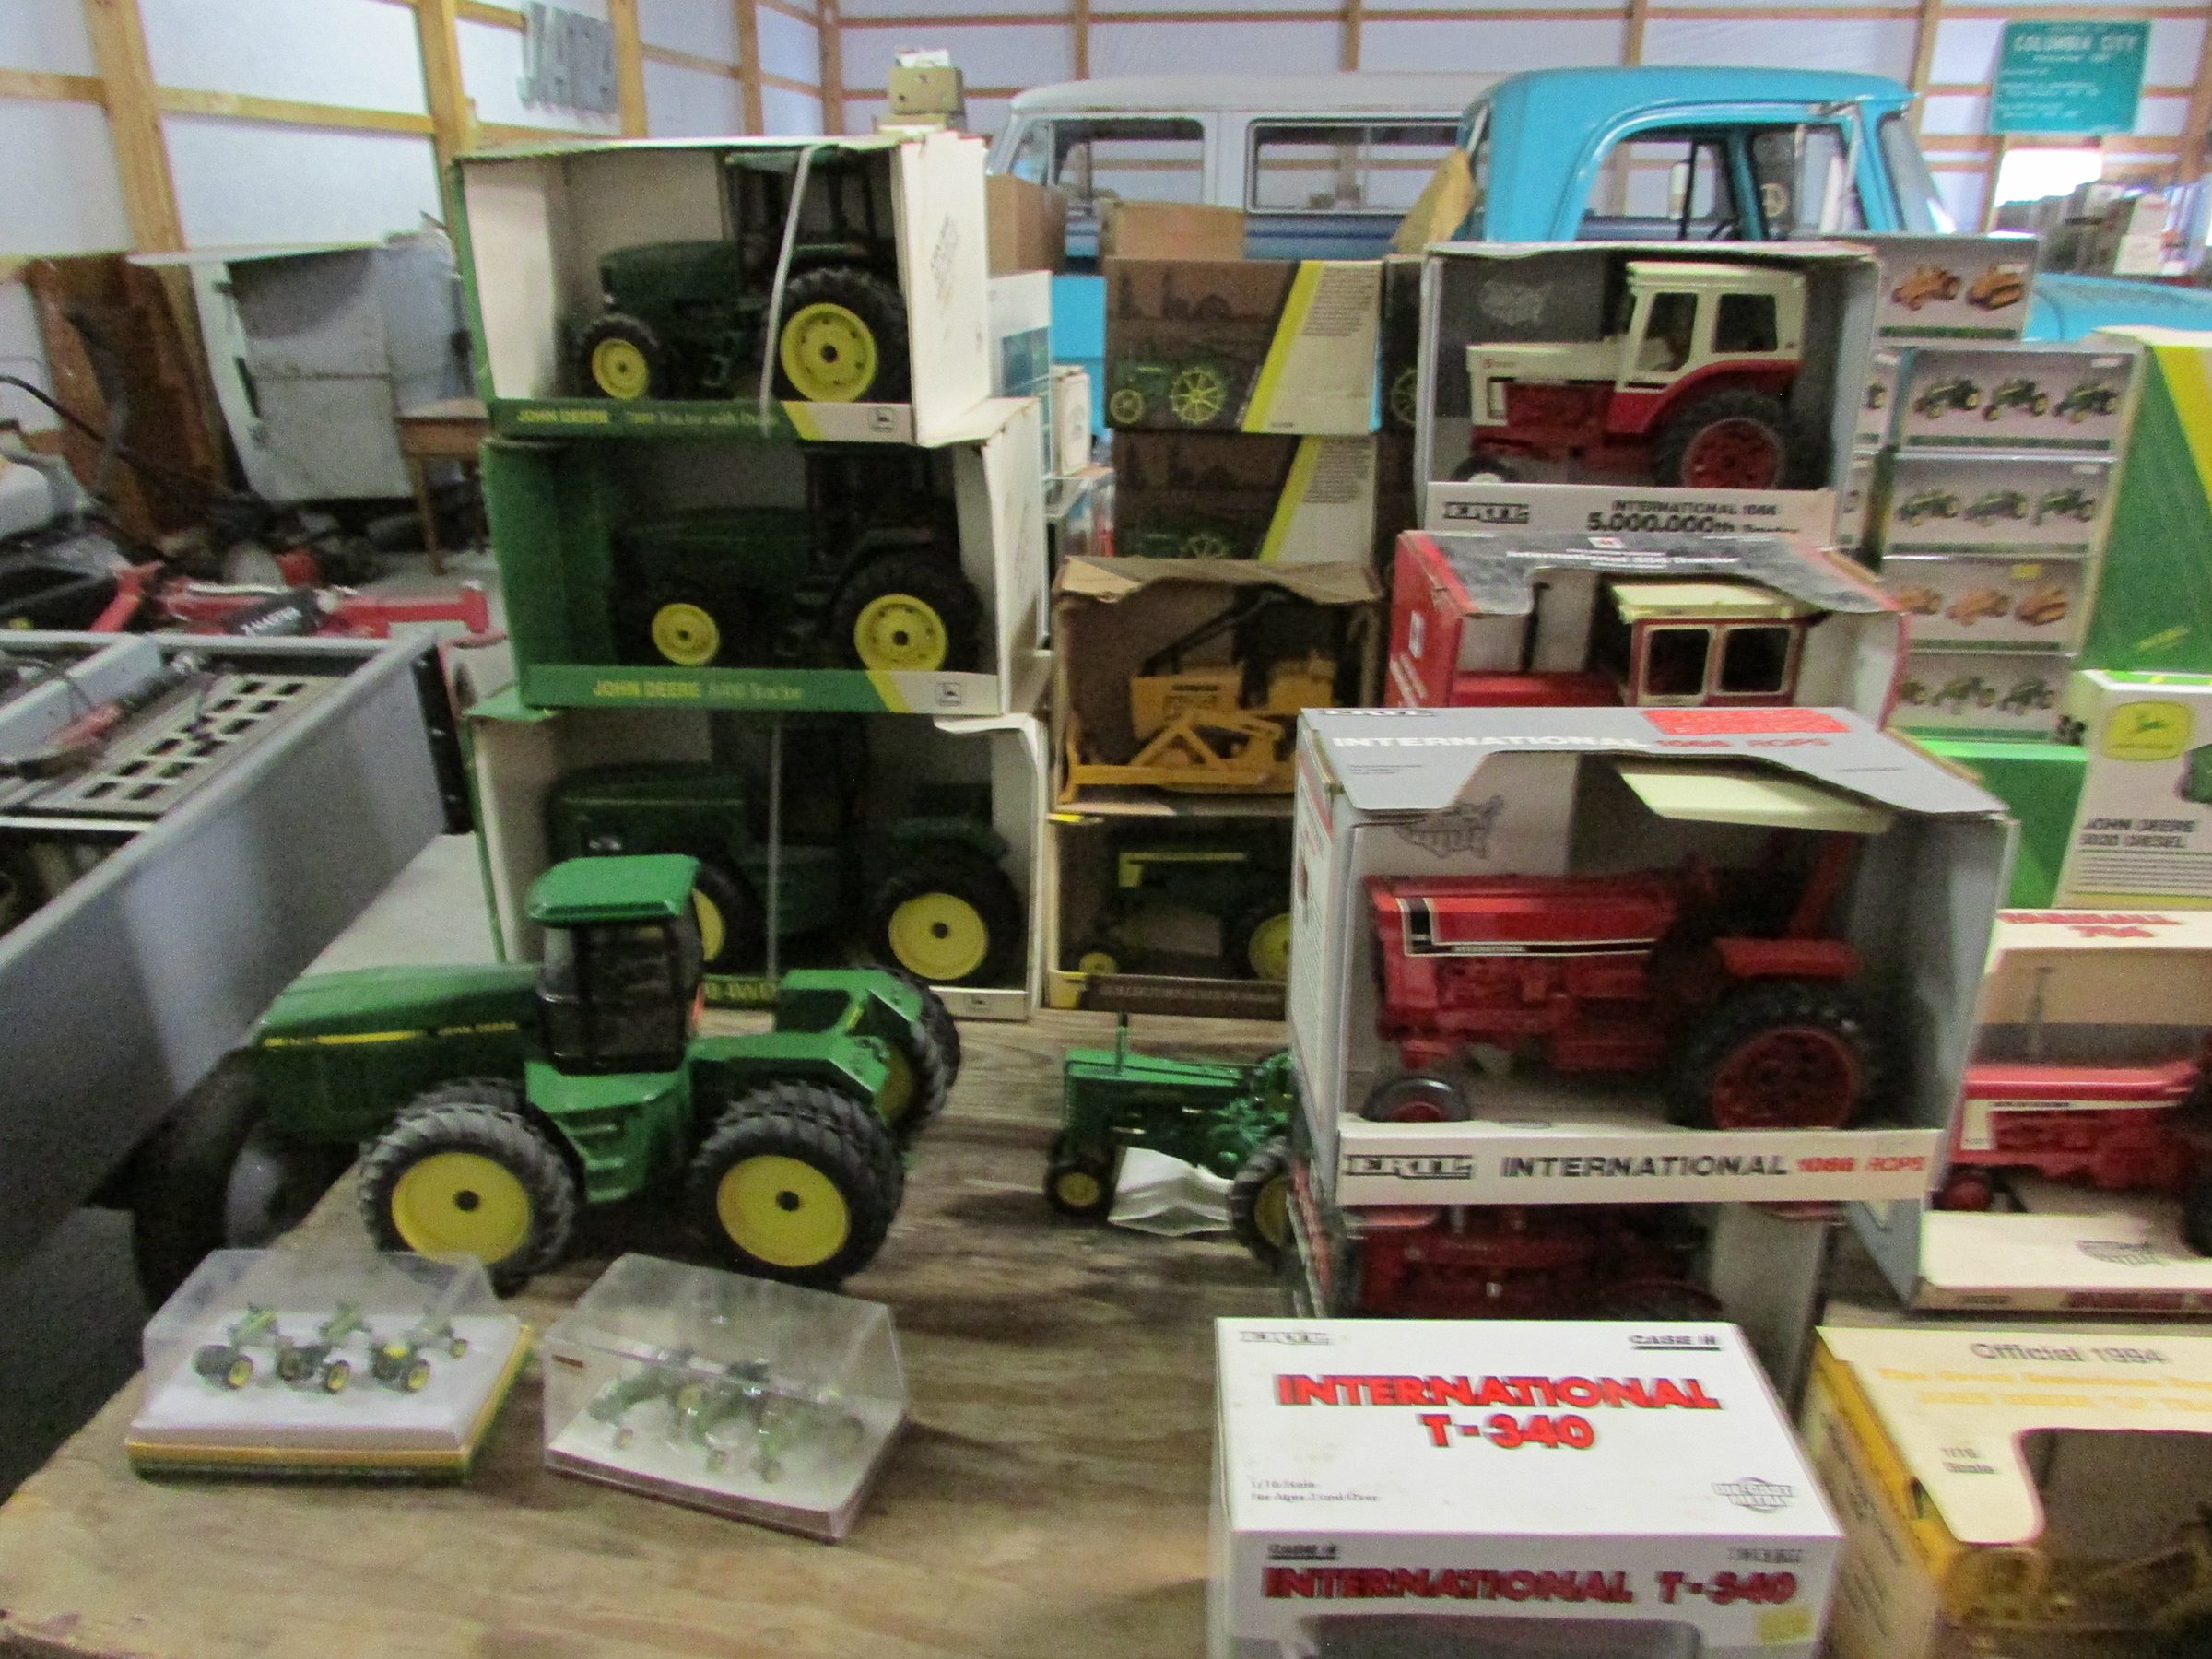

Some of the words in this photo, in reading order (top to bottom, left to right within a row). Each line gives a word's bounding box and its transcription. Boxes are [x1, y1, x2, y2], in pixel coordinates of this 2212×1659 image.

[1611, 500, 1738, 515] INTERNATIONAL
[1333, 736, 1652, 747] INTERNATIONAL
[1342, 1153, 1474, 1181] ERTL
[1500, 1154, 1790, 1178] INTERNATIONAL
[1970, 1342, 2085, 1362] Official
[1274, 1374, 1724, 1410] INTERNATIONAL
[1420, 1413, 1596, 1450] T-340
[1261, 1568, 1634, 1605] INTERNATIONAL
[1657, 1571, 1799, 1606] T-340
